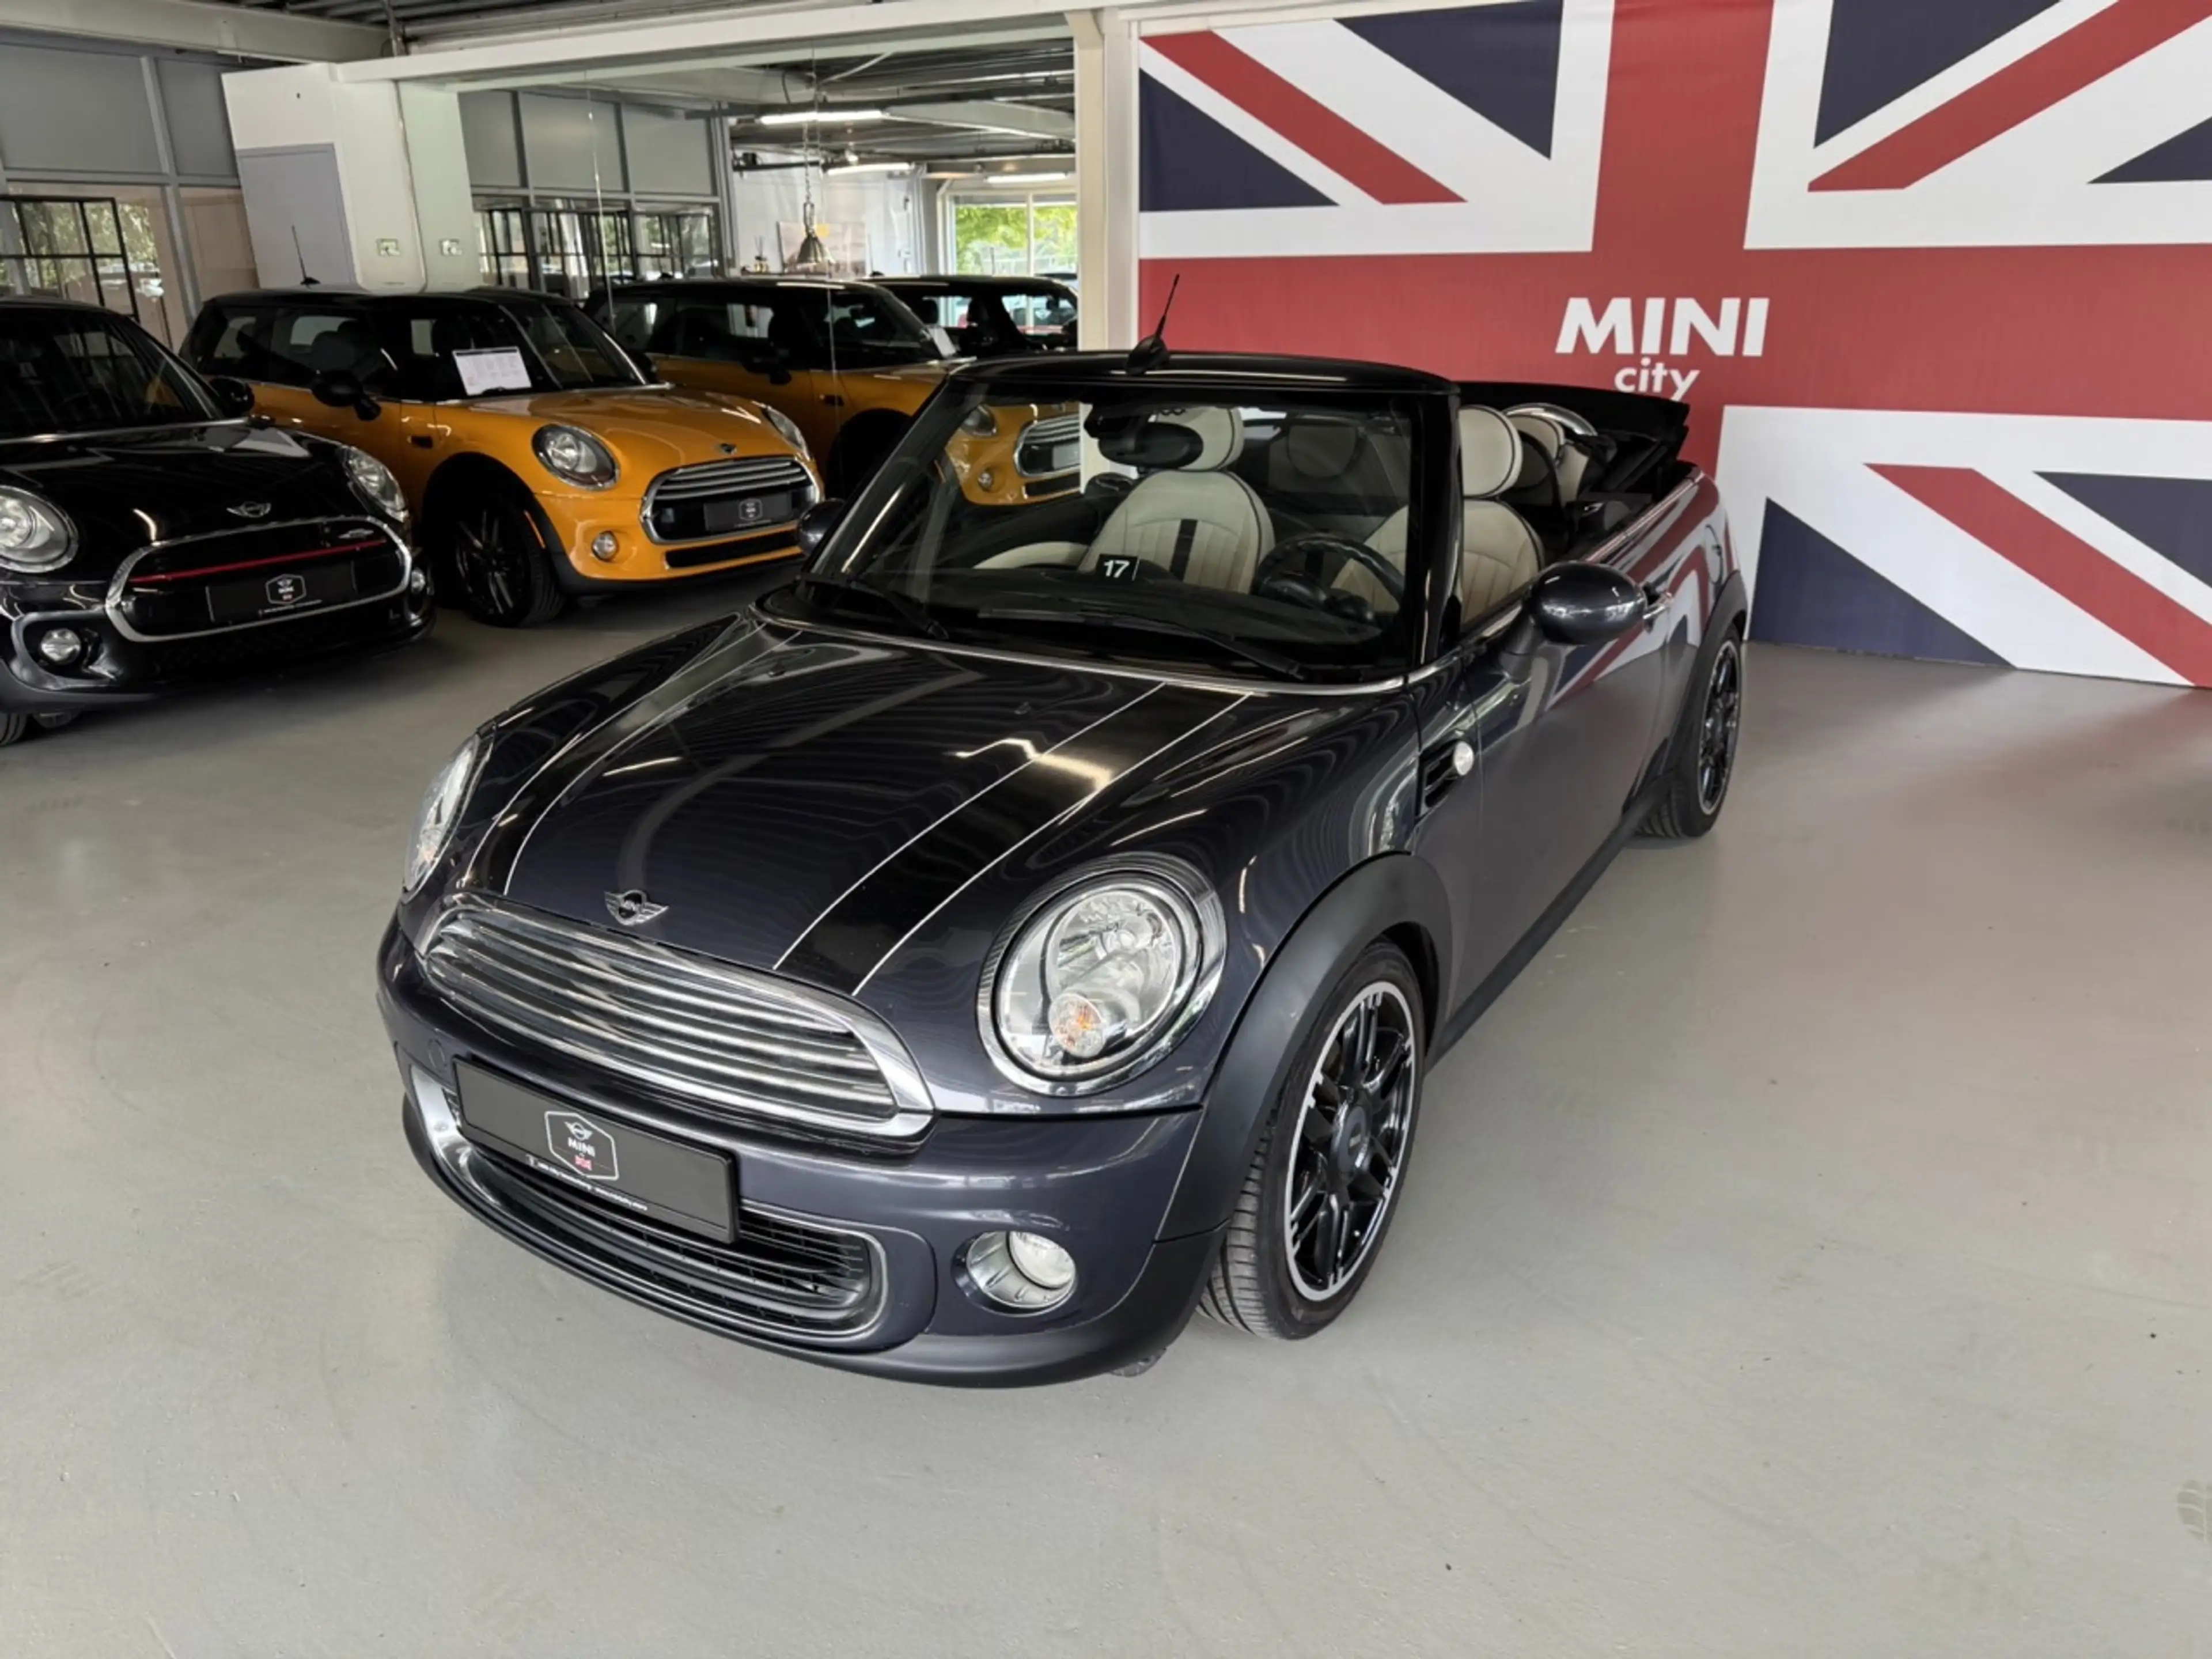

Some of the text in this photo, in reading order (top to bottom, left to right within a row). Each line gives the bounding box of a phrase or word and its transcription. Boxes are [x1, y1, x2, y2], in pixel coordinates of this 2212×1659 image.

[1555, 297, 1770, 357] MINI
[1615, 357, 1700, 401] city
[1104, 560, 1130, 578] 17
